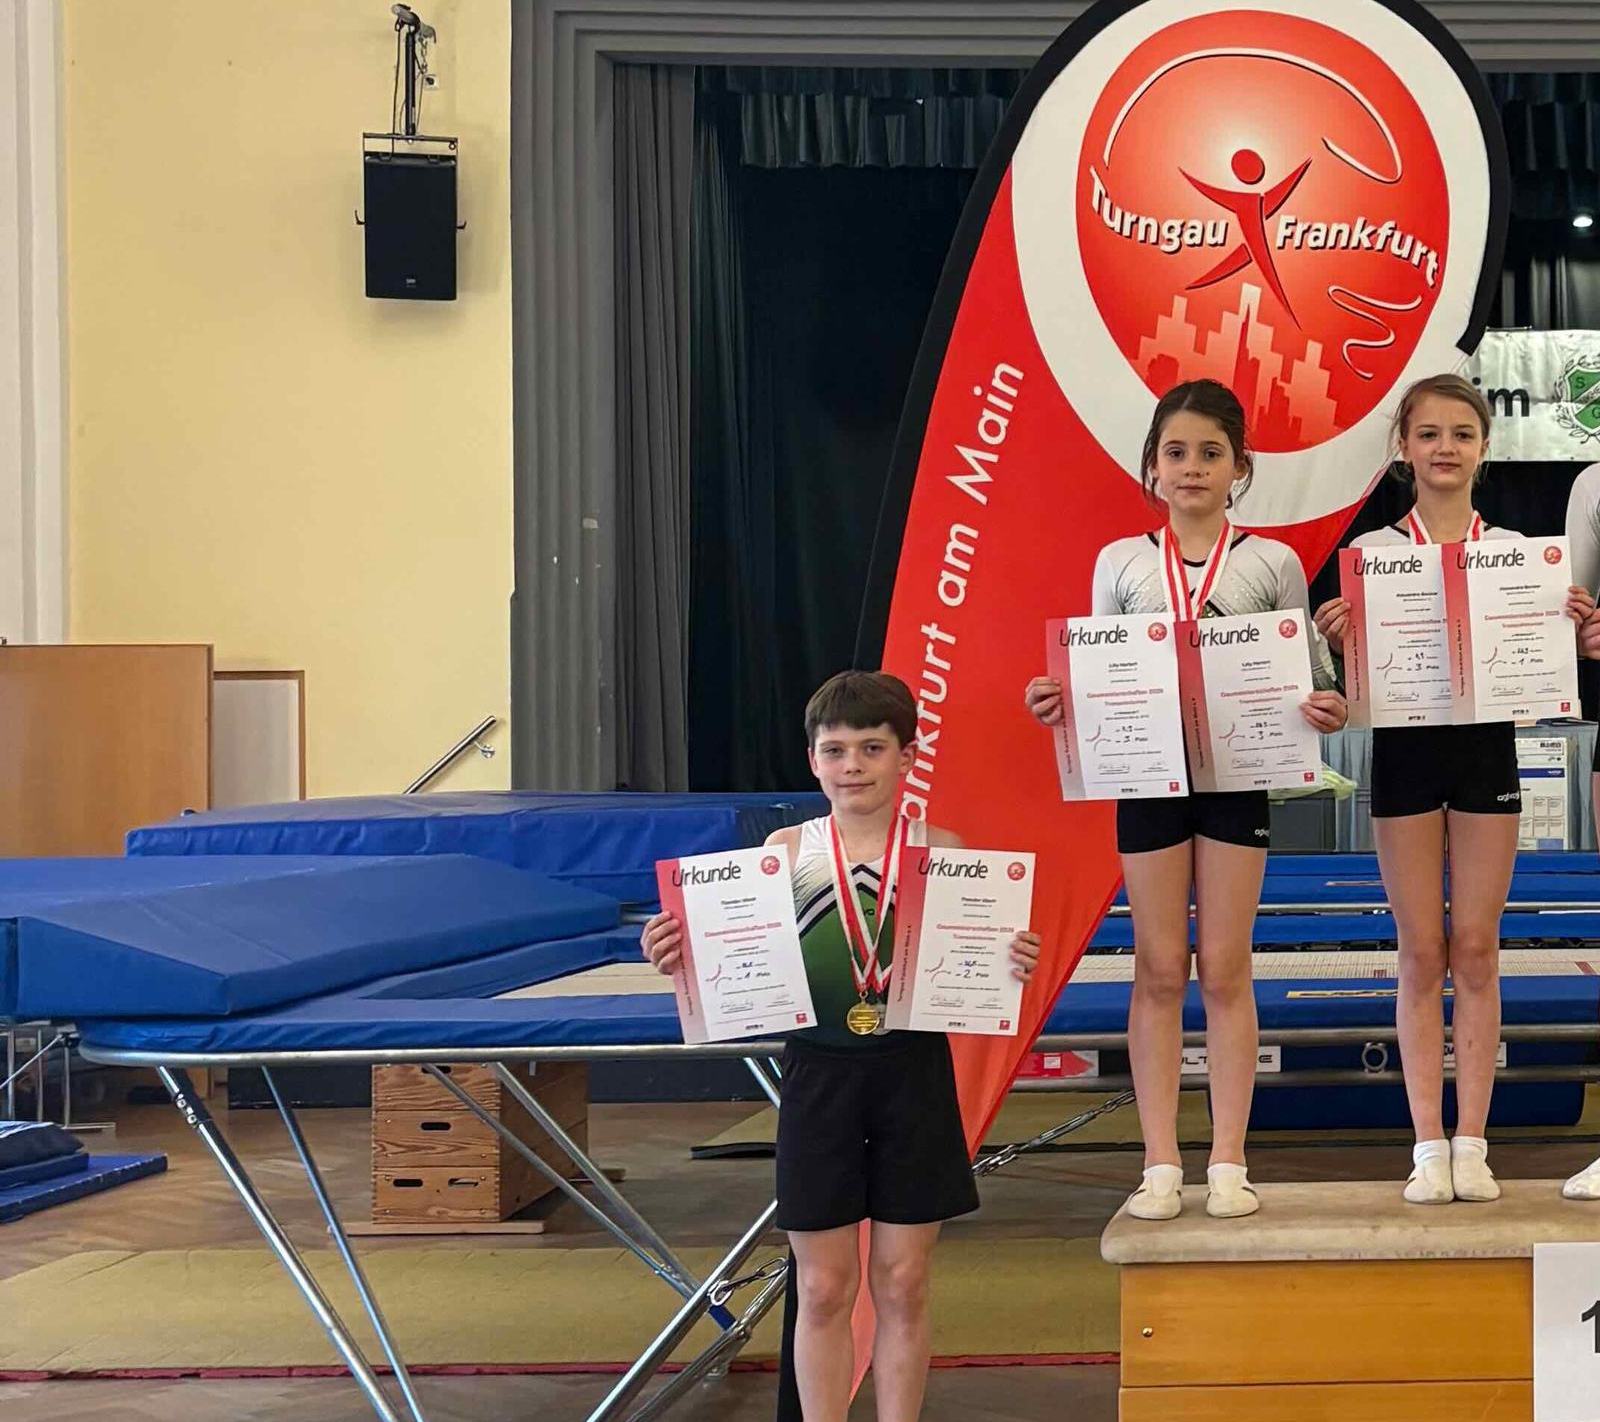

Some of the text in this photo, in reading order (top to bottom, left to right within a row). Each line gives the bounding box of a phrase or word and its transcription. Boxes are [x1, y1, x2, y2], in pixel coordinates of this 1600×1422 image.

[1089, 165, 1439, 287] Turngau Frankfurt
[945, 361, 1025, 506] Main
[938, 522, 979, 607] am
[1353, 554, 1423, 576] Urkunde
[1456, 548, 1526, 571] Urkunde
[1059, 624, 1129, 647] Urkunde
[1189, 623, 1260, 648] Urkunde
[672, 860, 742, 887] Urkunde
[918, 856, 989, 880] Urkunde
